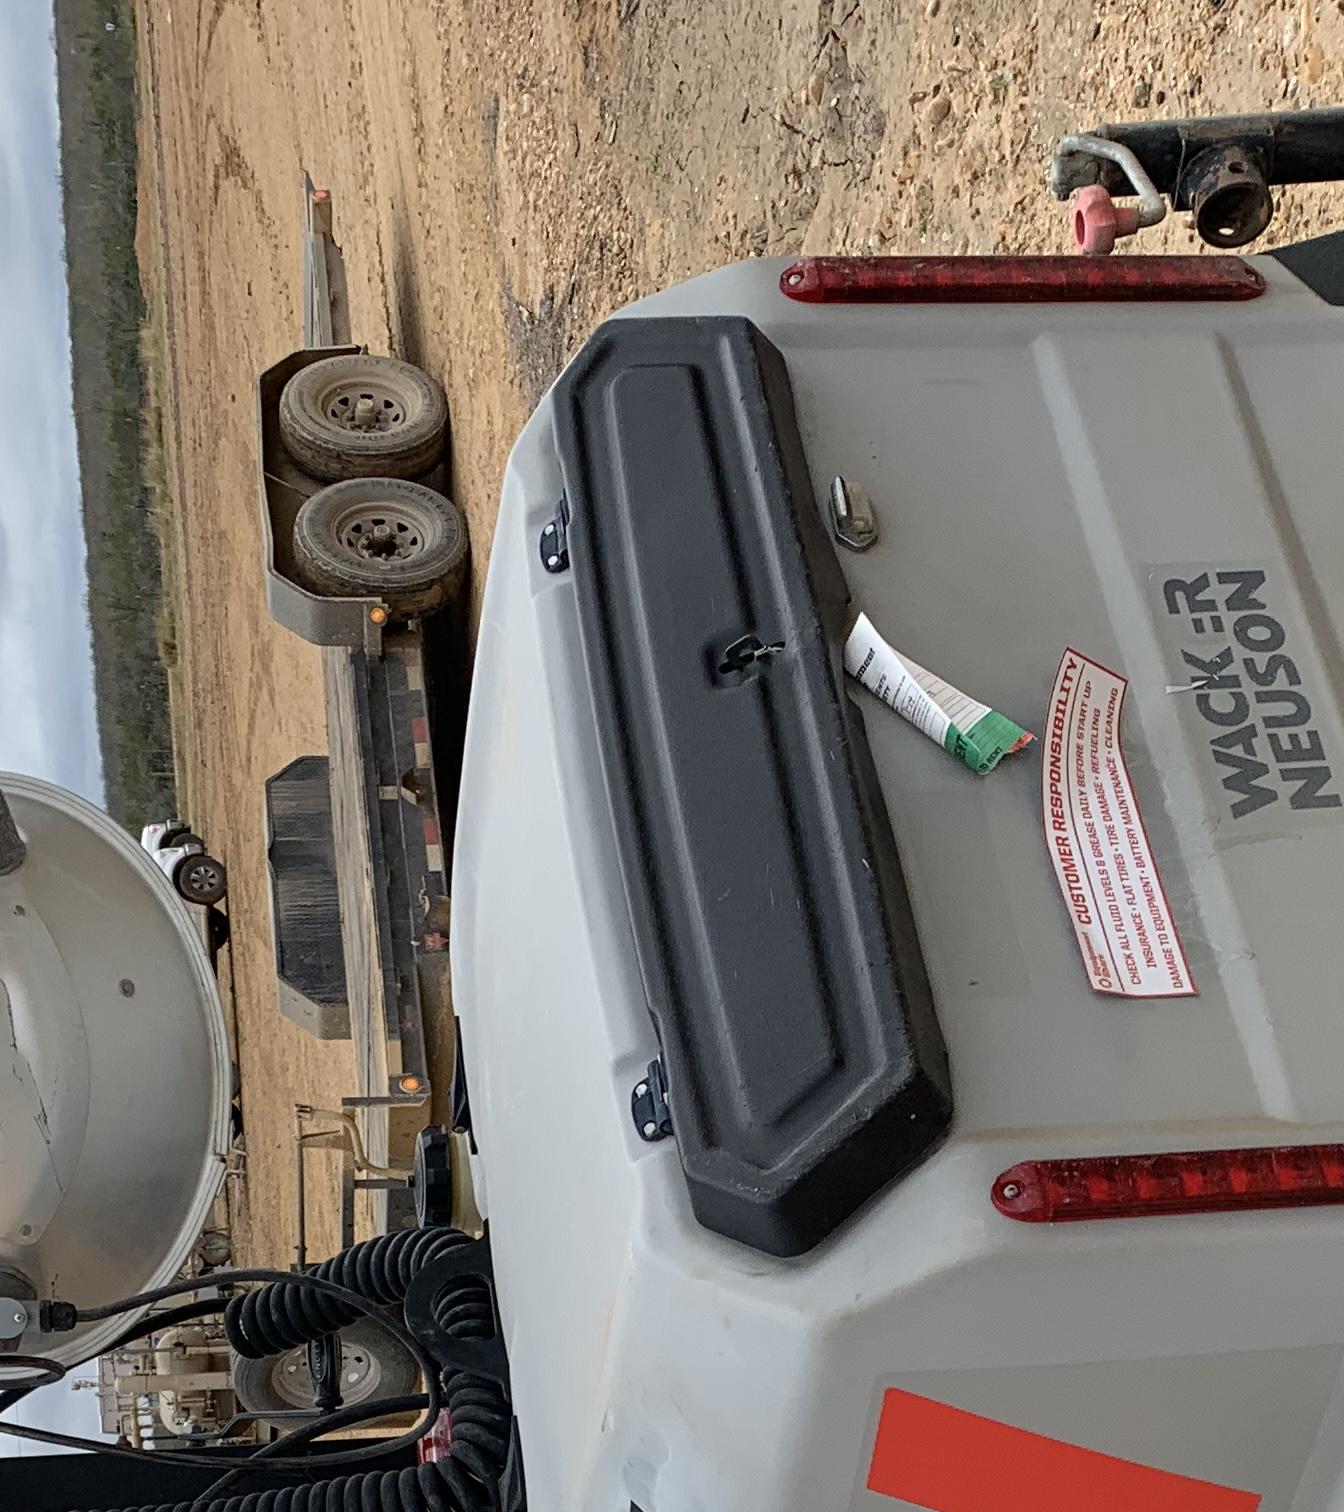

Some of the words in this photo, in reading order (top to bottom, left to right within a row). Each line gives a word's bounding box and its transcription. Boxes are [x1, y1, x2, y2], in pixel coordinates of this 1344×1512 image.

[1083, 680, 1092, 698] UP
[1216, 570, 1343, 810] NEUSON
[1076, 701, 1088, 740] START
[1104, 688, 1118, 748] CLEANING
[1050, 658, 1078, 832] RESPONSIBILITY
[1090, 708, 1101, 774] REFUELING
[1076, 742, 1086, 788] BEFORE
[1078, 788, 1092, 819] DAILY
[1093, 782, 1113, 822] DAMAGE
[1106, 756, 1133, 825] MAINTENANCE
[1084, 822, 1103, 858] GREASE
[1104, 824, 1120, 846] TIRE
[1124, 826, 1146, 868] BATTERY
[1055, 836, 1092, 924] CUSTOMER
[1098, 869, 1116, 902] LEVELS
[1114, 854, 1130, 882] TIRES
[1122, 884, 1137, 906] FLAT
[1140, 875, 1166, 932] EQUIPMENT
[1108, 904, 1125, 932] FLUID
[1118, 934, 1131, 950] ALL
[1130, 912, 1157, 968] INSURANCE
[1158, 934, 1170, 946] TO
[1122, 952, 1142, 984] CHECK
[1162, 948, 1184, 988] DAMAGE
